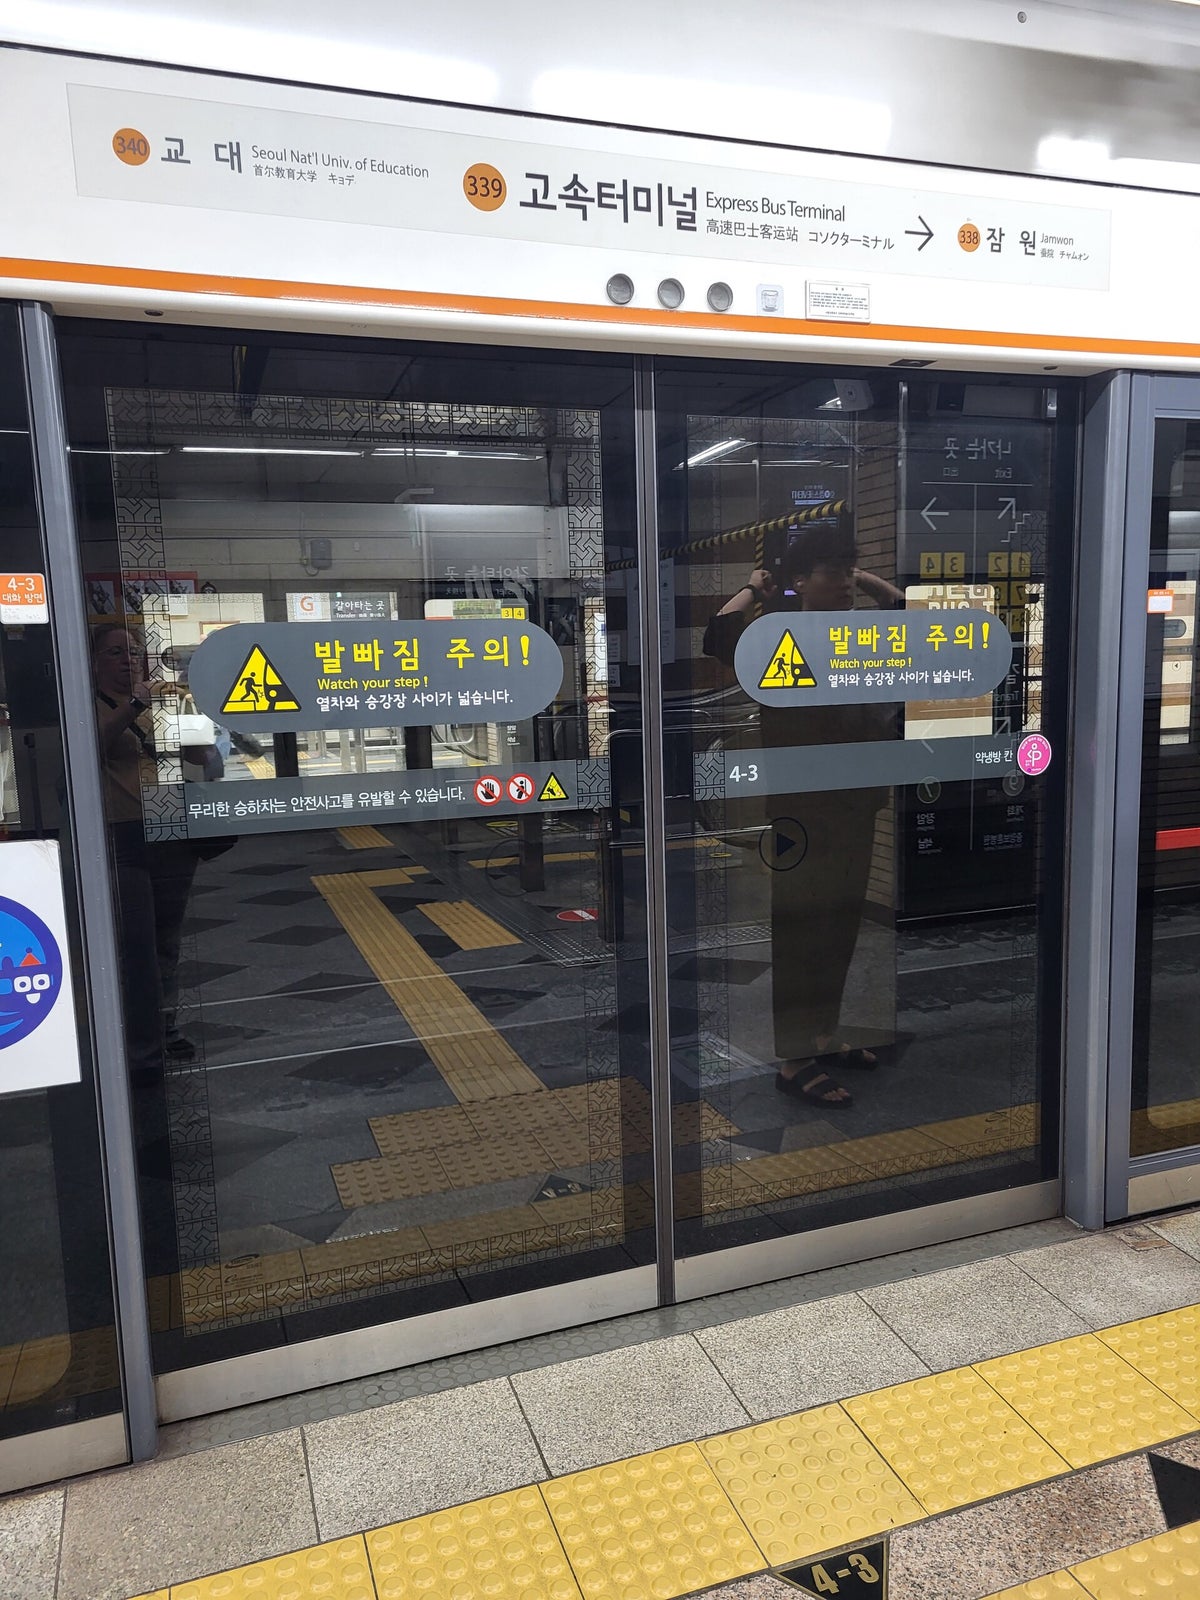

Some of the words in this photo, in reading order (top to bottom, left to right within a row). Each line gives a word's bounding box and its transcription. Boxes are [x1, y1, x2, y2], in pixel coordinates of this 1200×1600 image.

[115, 136, 147, 156] 340
[251, 145, 287, 162] Seoul
[290, 149, 319, 166] Nat'l
[321, 153, 353, 170] Univ.
[355, 158, 368, 171] of
[370, 159, 430, 178] Education
[252, 163, 318, 183] 首尔教育大学
[467, 175, 503, 198] 339
[519, 172, 697, 232] 고속터미널
[706, 191, 759, 214] Express
[761, 197, 786, 216] Bus
[787, 200, 846, 222] Terminal
[706, 218, 799, 242] 高速巴士客运站
[808, 230, 895, 251] コソクターミナル
[959, 230, 979, 245] 338
[1040, 233, 1074, 246] Jamwon
[8, 577, 35, 591] 4-3
[300, 595, 314, 611] G
[335, 601, 374, 611] 갈아타는
[376, 601, 386, 611] 곳
[829, 624, 907, 655] 발빠짐
[926, 622, 990, 652] 주의!
[314, 638, 420, 674] 발빠짐
[446, 635, 530, 669] 주의!
[830, 658, 860, 669] Watch
[862, 659, 884, 670] your
[317, 678, 358, 690] Watch
[362, 678, 390, 692] your
[828, 674, 861, 688] 열차와
[864, 672, 895, 687] 승강장
[898, 670, 929, 684] 사이가
[932, 669, 975, 684] 넓습니다.
[316, 695, 360, 713] 열차와
[364, 694, 406, 711] 승강장
[412, 691, 452, 707] 사이가
[457, 689, 514, 706] 넓습니다.
[975, 750, 1001, 764] 약냉방
[1003, 749, 1014, 763] 칸
[729, 764, 759, 782] 4-3
[188, 801, 230, 819] 무리한
[233, 798, 287, 817] 승하차는
[290, 793, 354, 812] 안전사고를
[357, 790, 395, 808] 유발할
[398, 789, 413, 804] 수
[415, 786, 466, 803] 있습니다.
[811, 1553, 880, 1594] 4-3
